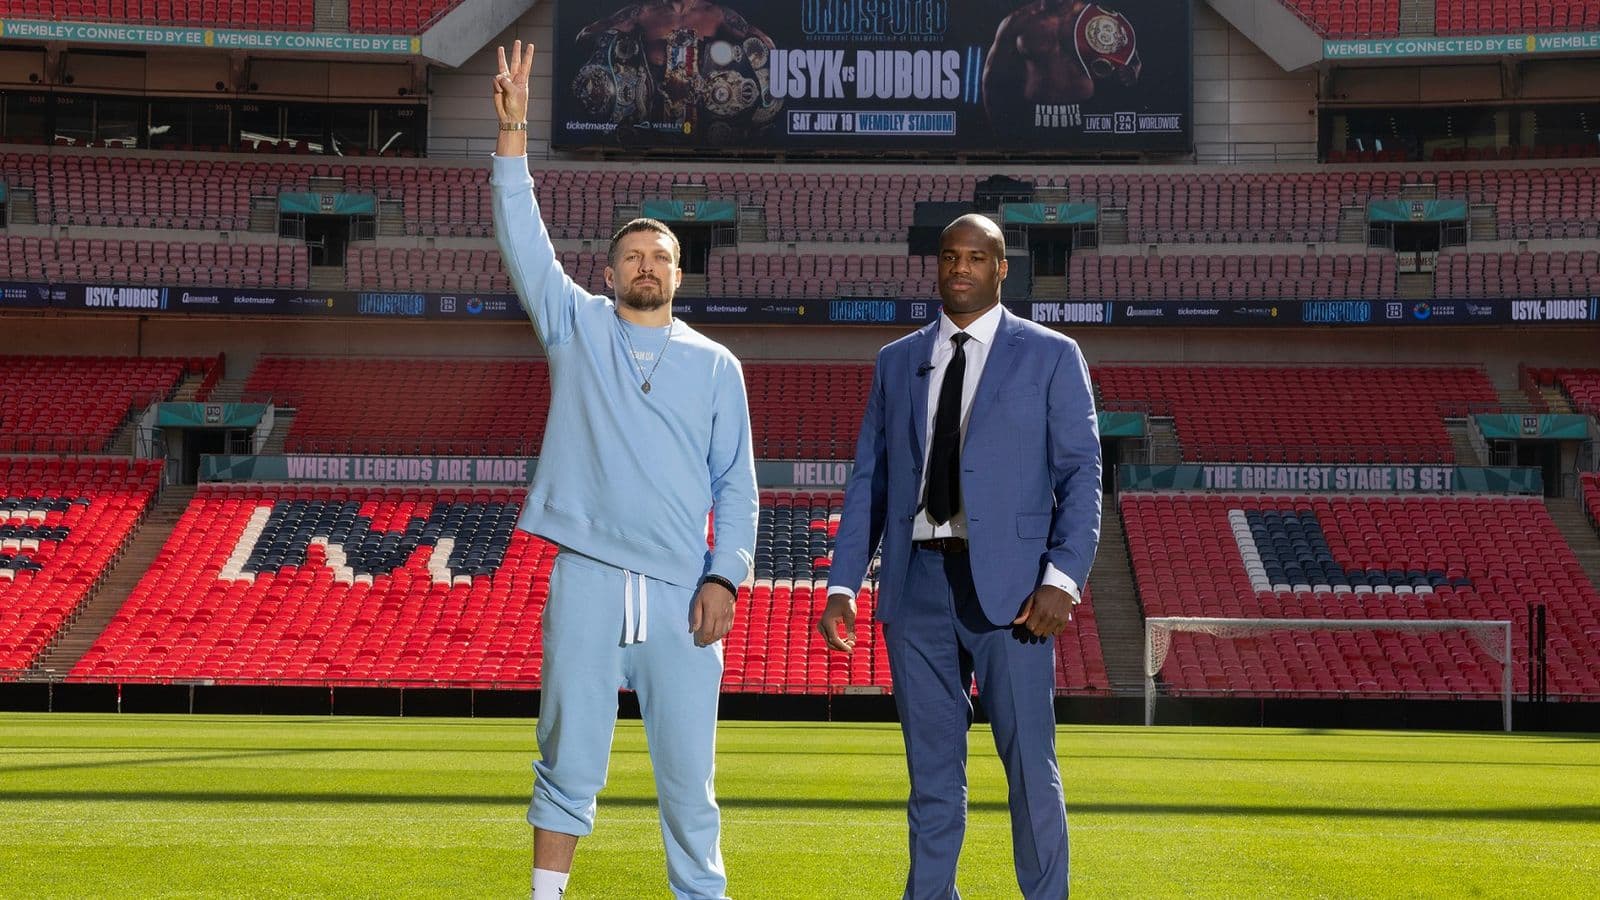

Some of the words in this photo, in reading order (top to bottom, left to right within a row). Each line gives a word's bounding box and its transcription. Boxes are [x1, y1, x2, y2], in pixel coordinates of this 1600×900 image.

[802, 0, 947, 34] UNDISPUTED
[8, 23, 73, 37] WEMBLEY
[77, 27, 163, 41] CONNECTED
[166, 32, 183, 42] BY
[186, 32, 201, 43] EE
[218, 34, 282, 46] WEMBLEY
[285, 36, 370, 49] CONNECTED
[373, 39, 390, 50] BY
[392, 39, 407, 50] EE
[1540, 35, 1600, 48] WEMBLE
[1327, 41, 1392, 55] WEMBLEY
[1396, 39, 1483, 53] CONNECTED
[1486, 38, 1505, 50] BY
[1507, 38, 1523, 49] EE
[770, 49, 845, 98] USYK
[856, 49, 960, 99] DUBOIS
[566, 121, 618, 130] ticketmaster
[793, 113, 811, 131] SAT
[814, 113, 838, 131] JULY
[841, 113, 853, 131] 19
[859, 114, 905, 130] WEMBLEY
[908, 114, 952, 131] STADIUM
[1086, 117, 1101, 130] LIVE
[1102, 117, 1111, 130] ON
[1139, 117, 1180, 130] WORLDWIDE
[85, 287, 115, 306] USYK
[119, 288, 158, 308] DUBOIS
[1032, 303, 1060, 321] USYK
[1064, 303, 1103, 322] DUBOIS
[1178, 307, 1220, 315] ticketmaster
[1512, 300, 1541, 320] USYK
[1546, 300, 1587, 320] DUBOIS
[287, 457, 350, 479] WHERE
[354, 458, 433, 480] LEGENDS
[437, 459, 471, 480] ARE
[476, 459, 527, 481] MADE
[793, 462, 846, 485] HELLO
[1204, 466, 1236, 488] THE
[1241, 467, 1330, 489] GREATEST
[1335, 467, 1391, 489] STAGE
[1396, 467, 1415, 489] IS
[1420, 467, 1453, 489] SET
